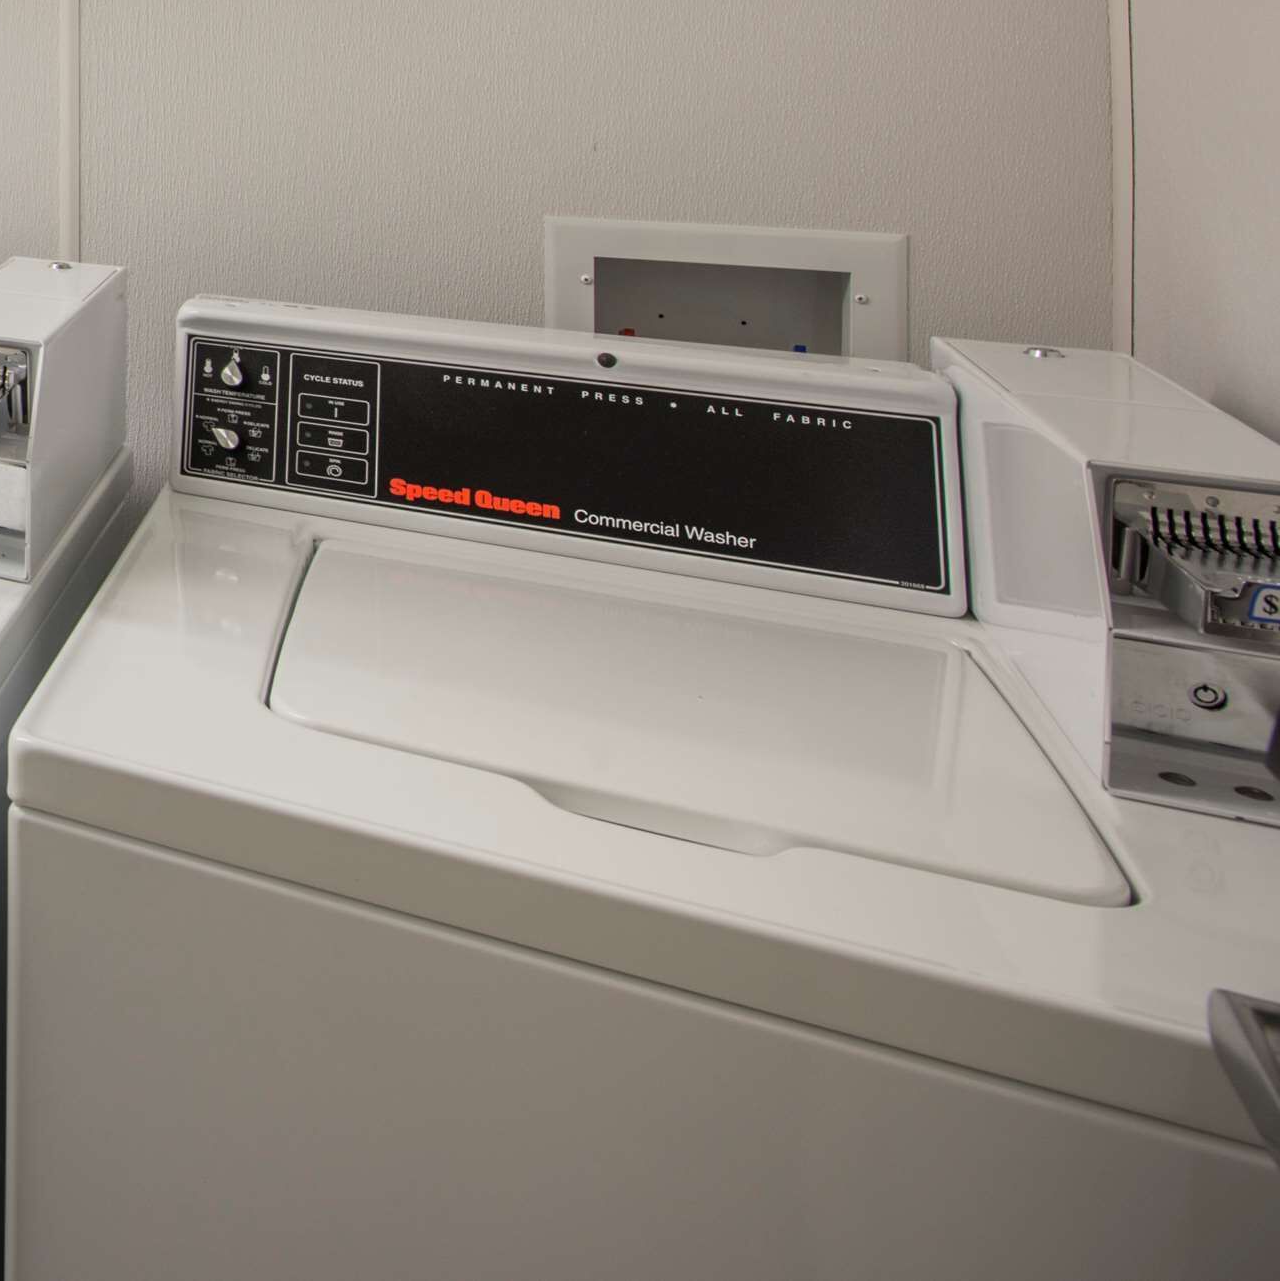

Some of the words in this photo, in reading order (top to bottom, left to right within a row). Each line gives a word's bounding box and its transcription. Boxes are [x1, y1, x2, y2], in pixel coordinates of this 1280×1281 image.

[303, 374, 331, 383] CYCLE
[333, 377, 364, 387] STATUS
[443, 375, 554, 394] PERMANENT
[581, 391, 643, 405] PRESS
[707, 405, 743, 417] ALL
[773, 412, 851, 429] FABRIC
[389, 478, 470, 502] Speed
[474, 489, 561, 519] Queen
[574, 509, 679, 537] Commercial
[684, 525, 757, 548] Washer
